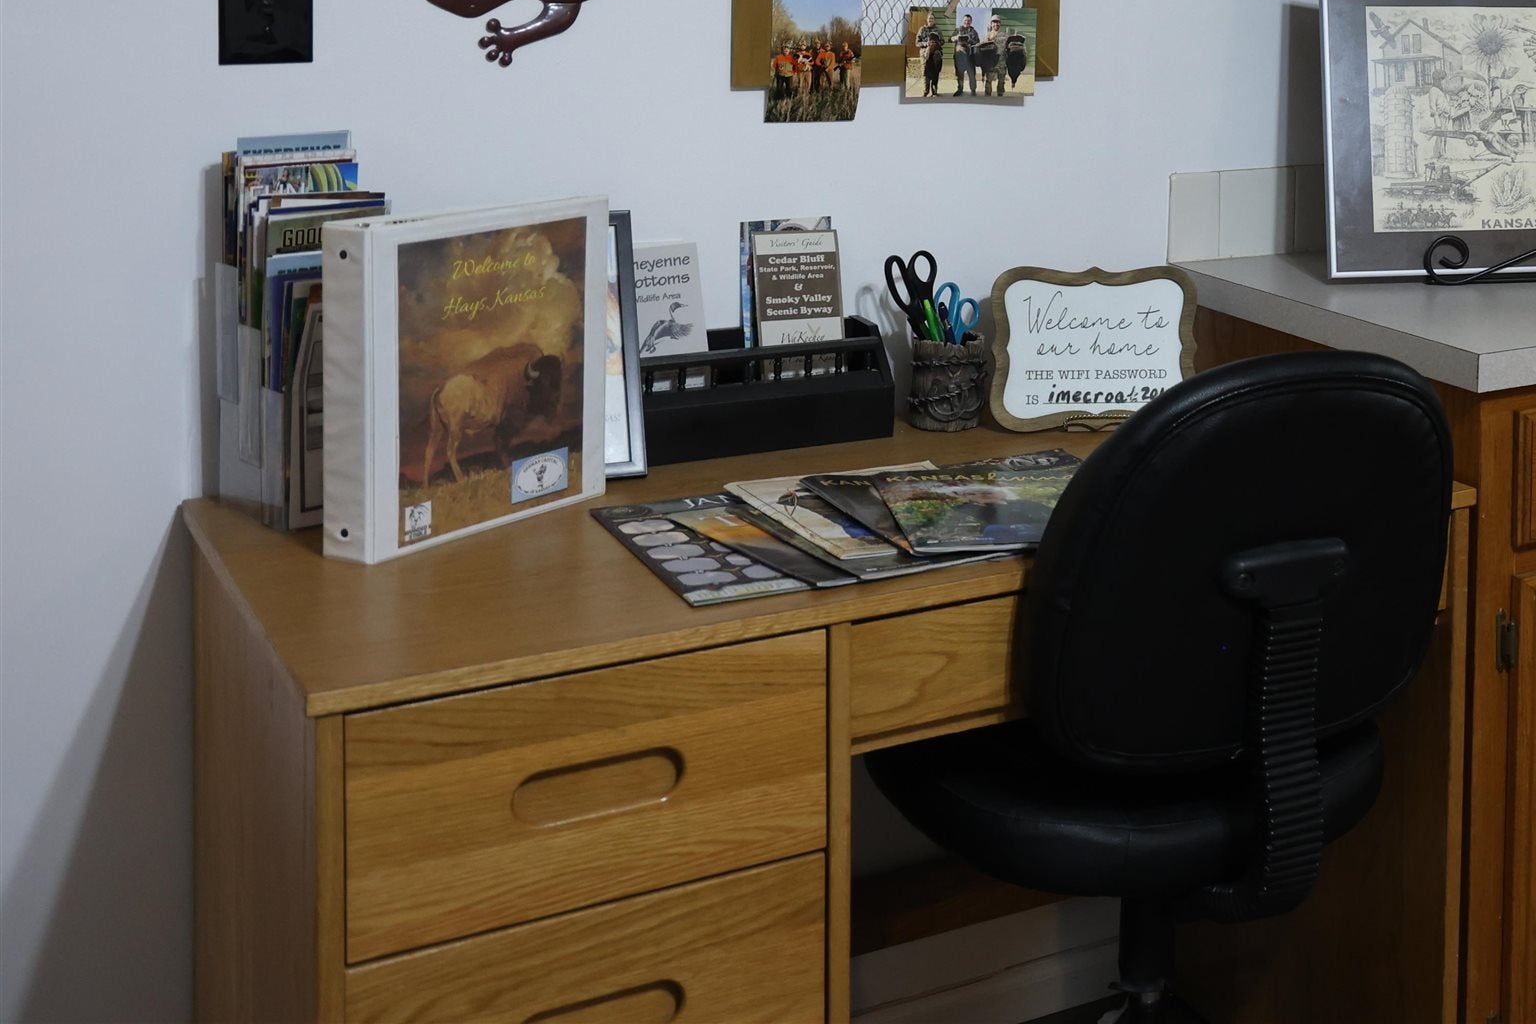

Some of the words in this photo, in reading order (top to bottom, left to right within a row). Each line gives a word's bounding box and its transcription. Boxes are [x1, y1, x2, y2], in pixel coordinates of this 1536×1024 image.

[769, 238, 799, 248] Visitors'
[802, 234, 824, 250] Guide
[769, 256, 798, 265] Cedar
[800, 255, 825, 263] Bluff
[453, 256, 520, 280] Welcome
[524, 252, 536, 268] to
[779, 273, 806, 281] Wildlife
[794, 283, 803, 291] &
[488, 286, 546, 311] Kansas
[662, 293, 681, 301] Area
[766, 296, 800, 305] Smoky
[802, 294, 833, 303] Valley
[766, 307, 798, 316] Scenic
[800, 306, 833, 315] Byway
[1023, 291, 1133, 334] Welcome
[1137, 306, 1170, 329] to
[1037, 342, 1080, 356] our
[1089, 332, 1160, 356] home
[1025, 370, 1053, 380] THE
[1057, 369, 1089, 380] WIFI
[1094, 369, 1167, 379] PASSWORD
[1026, 395, 1039, 405] IS
[886, 473, 985, 483] KANSAS
